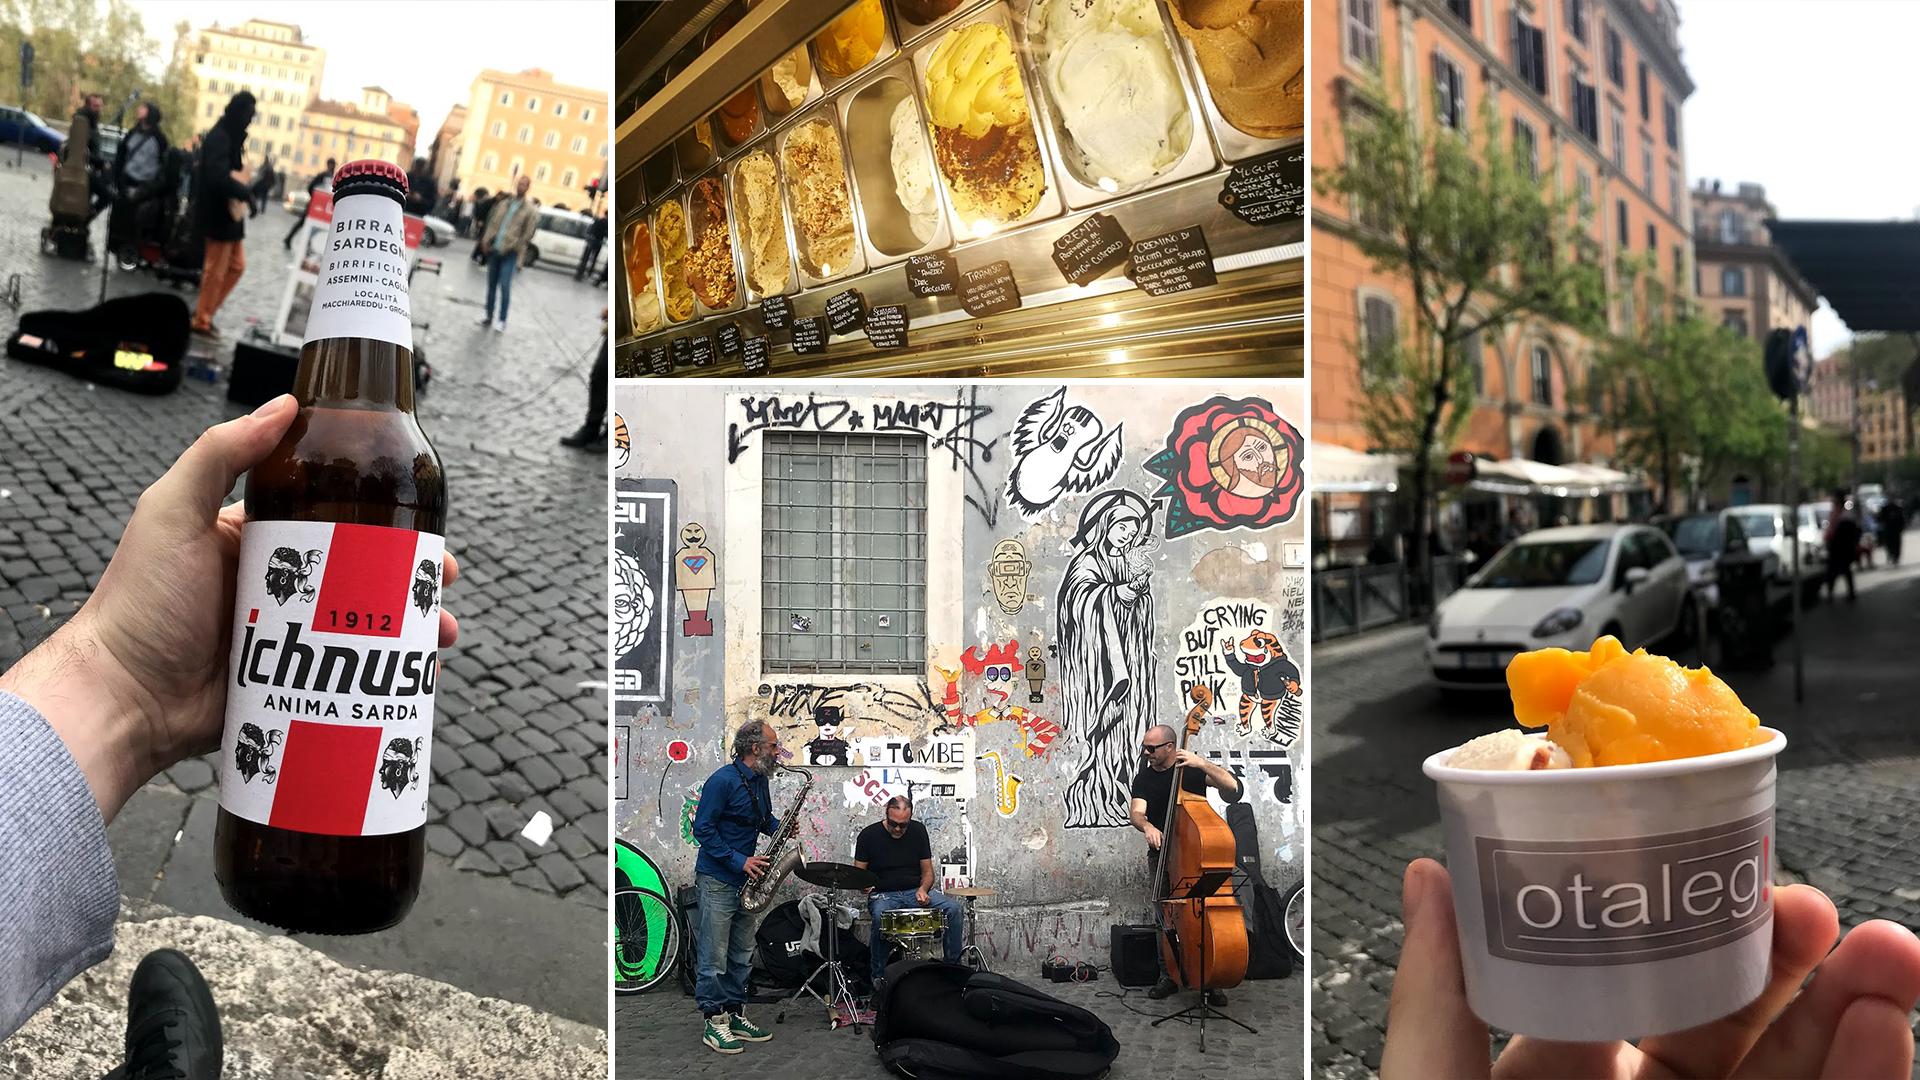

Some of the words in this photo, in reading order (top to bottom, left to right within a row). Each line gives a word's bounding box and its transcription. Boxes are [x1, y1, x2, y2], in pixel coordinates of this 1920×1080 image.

[1235, 160, 1279, 178] YOGURT
[1229, 173, 1280, 188] CIOCCOLATO
[336, 219, 393, 235] BIRRA
[1056, 217, 1101, 250] CREMA
[1136, 234, 1178, 253] CREMINO
[1181, 232, 1190, 240] DI
[329, 259, 402, 276] BIRRIFICIO
[1068, 261, 1091, 281] LEMON
[1091, 240, 1123, 264] CUSTARD
[1134, 251, 1162, 264] RICOTTA
[1136, 257, 1177, 273] CIOCCOLATO
[1177, 248, 1206, 260] SALATO
[1188, 260, 1206, 270] WITH
[326, 274, 373, 286] ASSEMINI
[921, 283, 952, 293] CHOCOLATE
[1154, 281, 1193, 295] CHOCOLATE
[322, 300, 383, 310] MACCHIAREDDU
[354, 290, 398, 304] LOCALITÀ
[330, 610, 391, 632] 1912
[1203, 603, 1267, 629] CRYING
[1185, 625, 1220, 653] BUT
[1176, 654, 1226, 677] STILL
[1181, 675, 1227, 711] PNK
[263, 693, 340, 718] ANIMA
[351, 703, 418, 721] SARDA
[886, 743, 964, 764] TOMBE
[883, 768, 904, 785] LA
[853, 770, 891, 807] SCE
[1517, 835, 1769, 929] otaleg!
